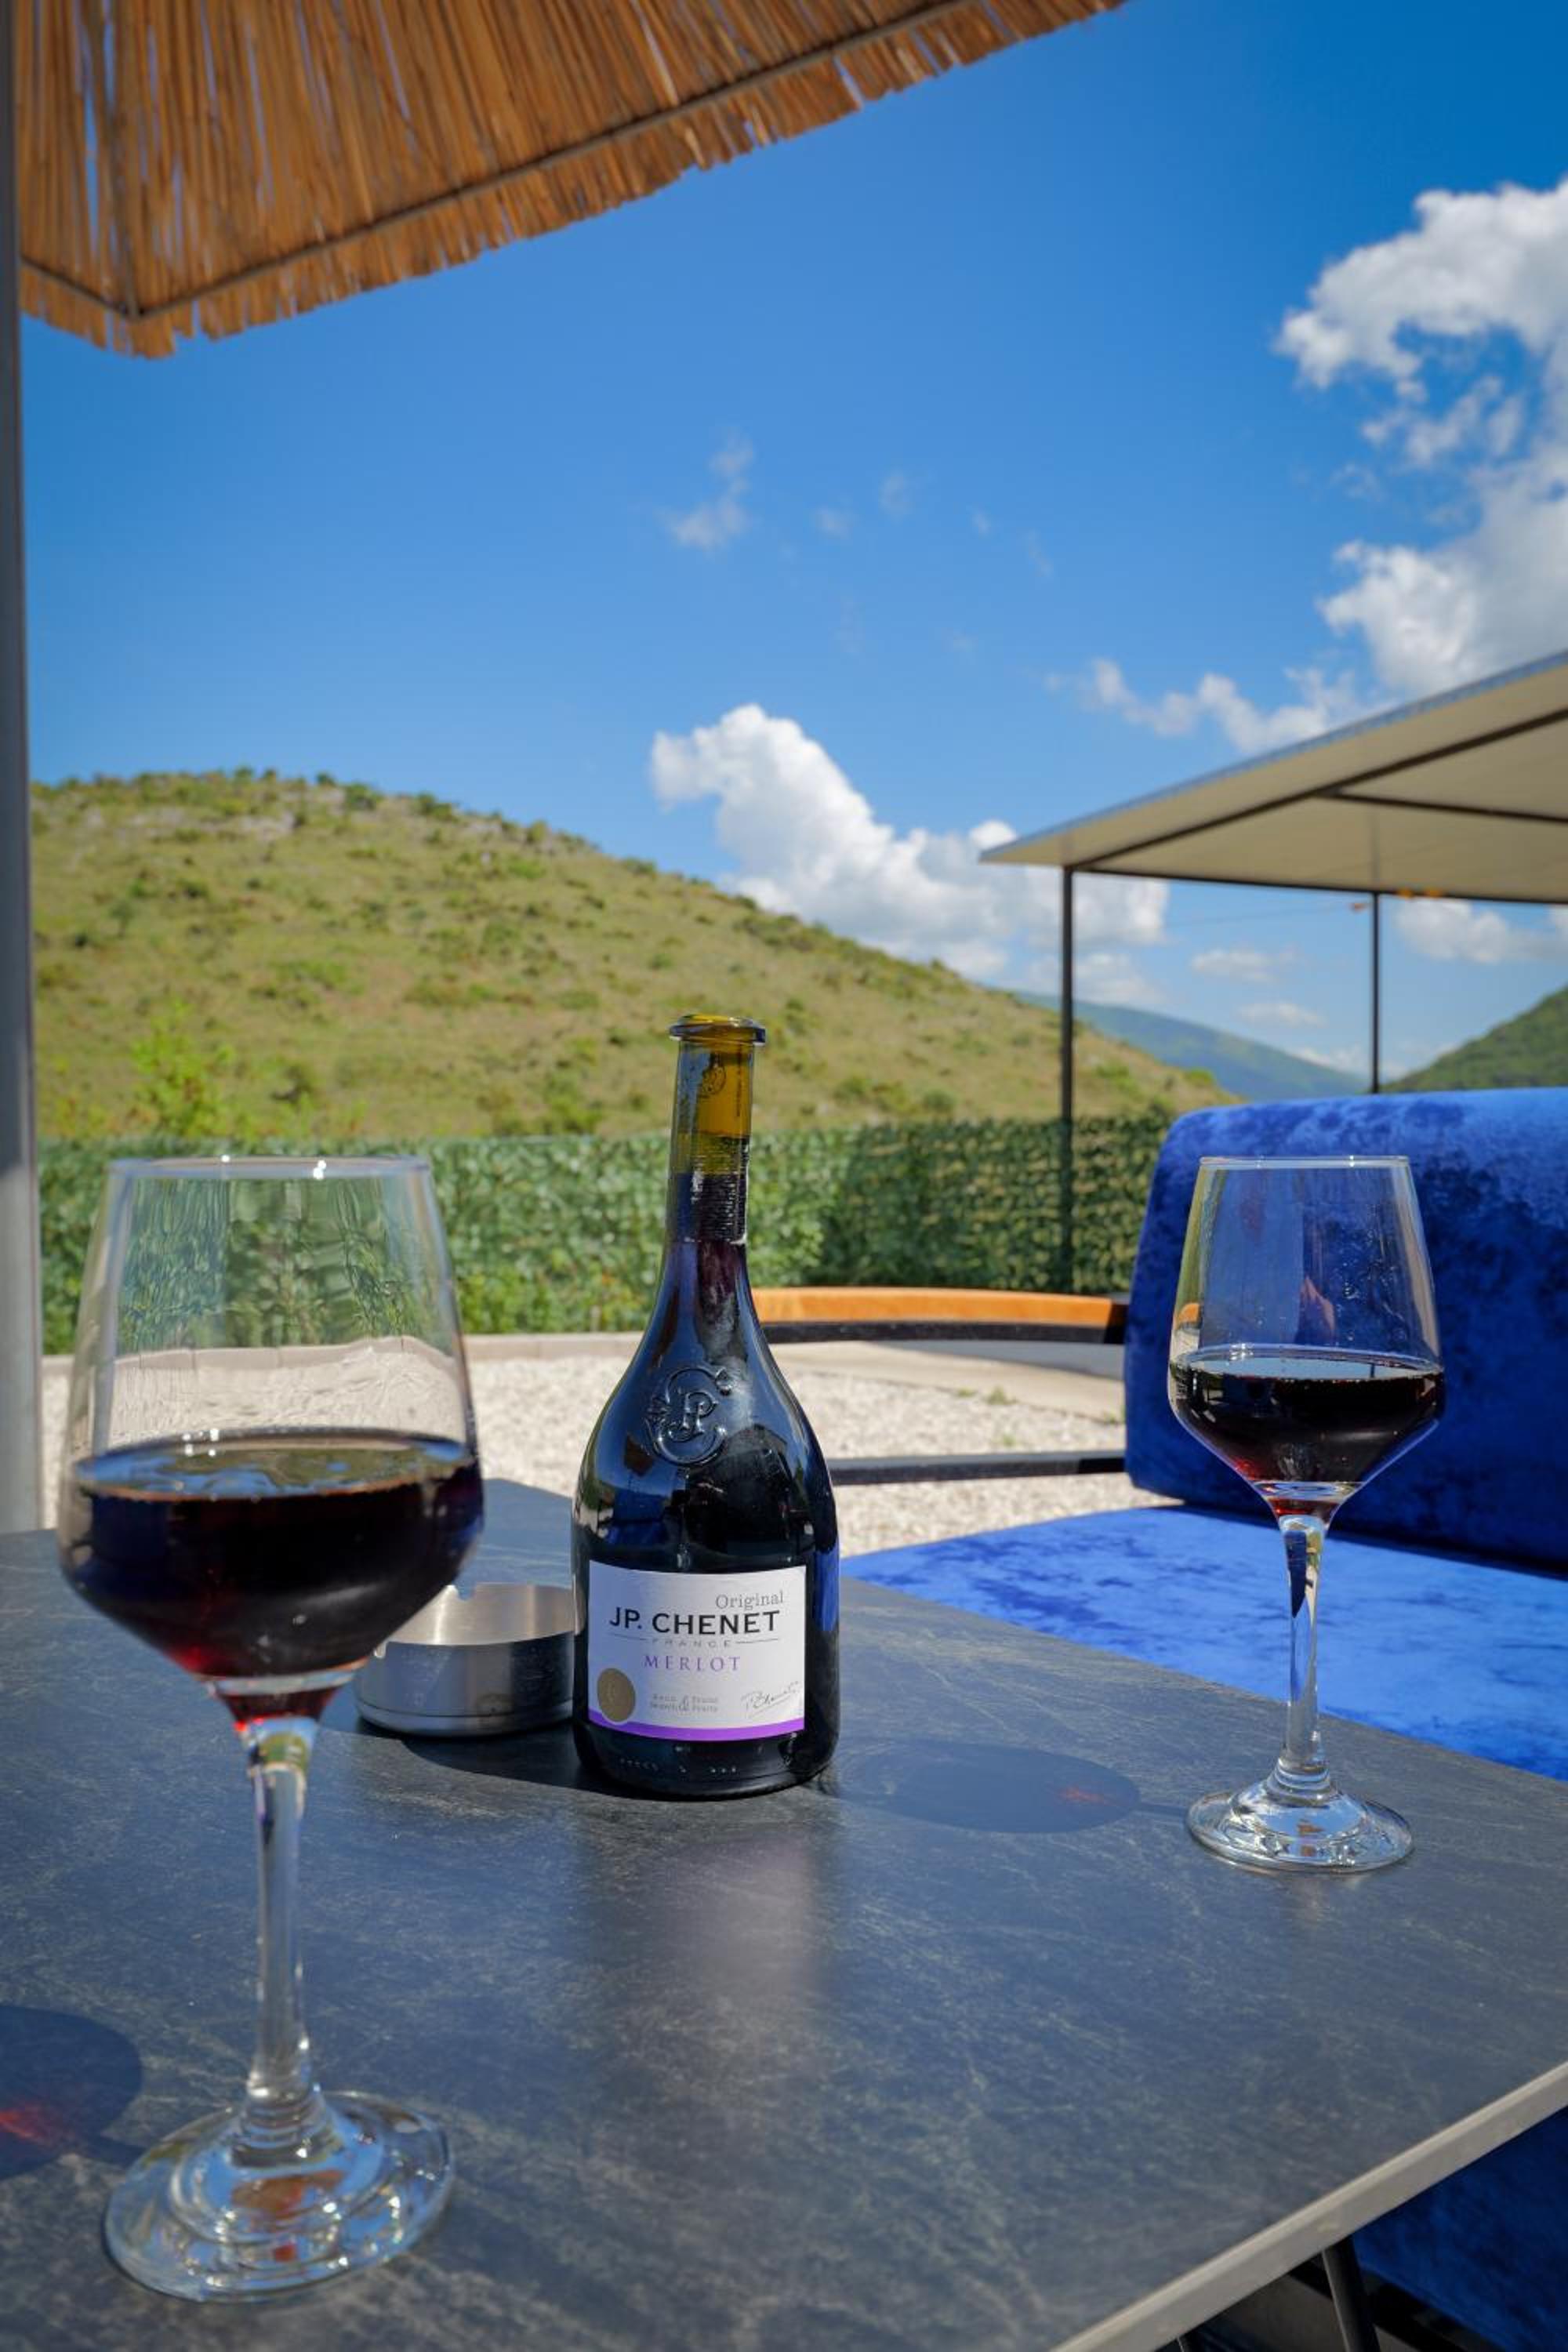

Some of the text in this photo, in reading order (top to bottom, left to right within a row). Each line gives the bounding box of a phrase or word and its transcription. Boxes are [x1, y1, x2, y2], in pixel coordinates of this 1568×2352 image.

[715, 1591, 784, 1610] Original
[609, 1606, 780, 1635] JP. CHENET
[643, 1654, 741, 1672] MERLOT
